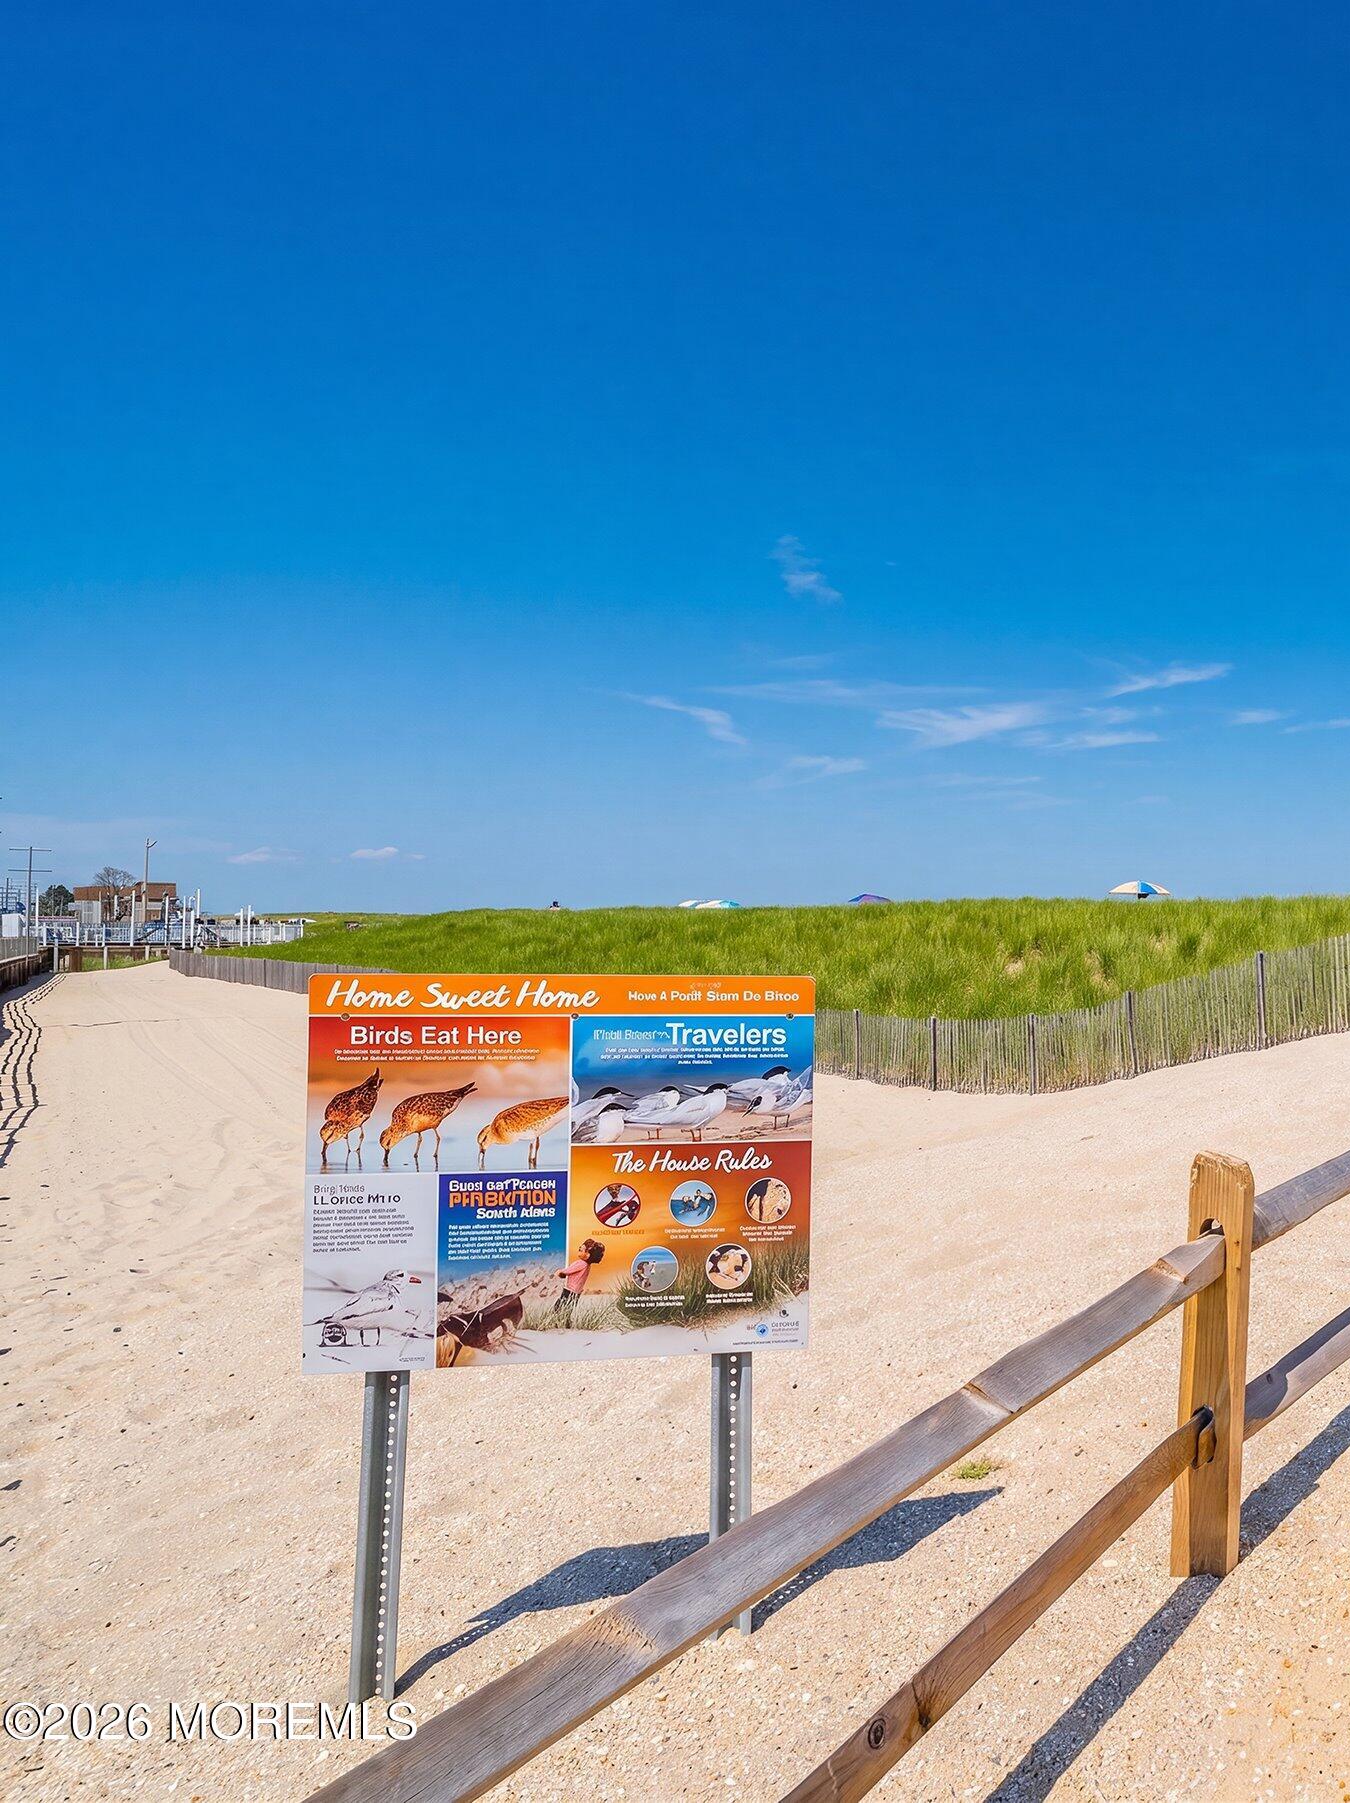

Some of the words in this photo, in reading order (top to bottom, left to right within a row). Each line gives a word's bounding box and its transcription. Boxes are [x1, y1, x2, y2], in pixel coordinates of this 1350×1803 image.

[325, 978, 414, 1008] Home
[420, 982, 511, 1010] Sweet
[515, 978, 601, 1008] Home
[350, 1025, 413, 1046] Birds
[420, 1025, 460, 1046] Eat
[467, 1025, 522, 1046] Here
[665, 1022, 788, 1046] Travelers
[612, 1150, 647, 1174] The
[648, 1149, 712, 1173] House
[714, 1146, 773, 1174] Rules
